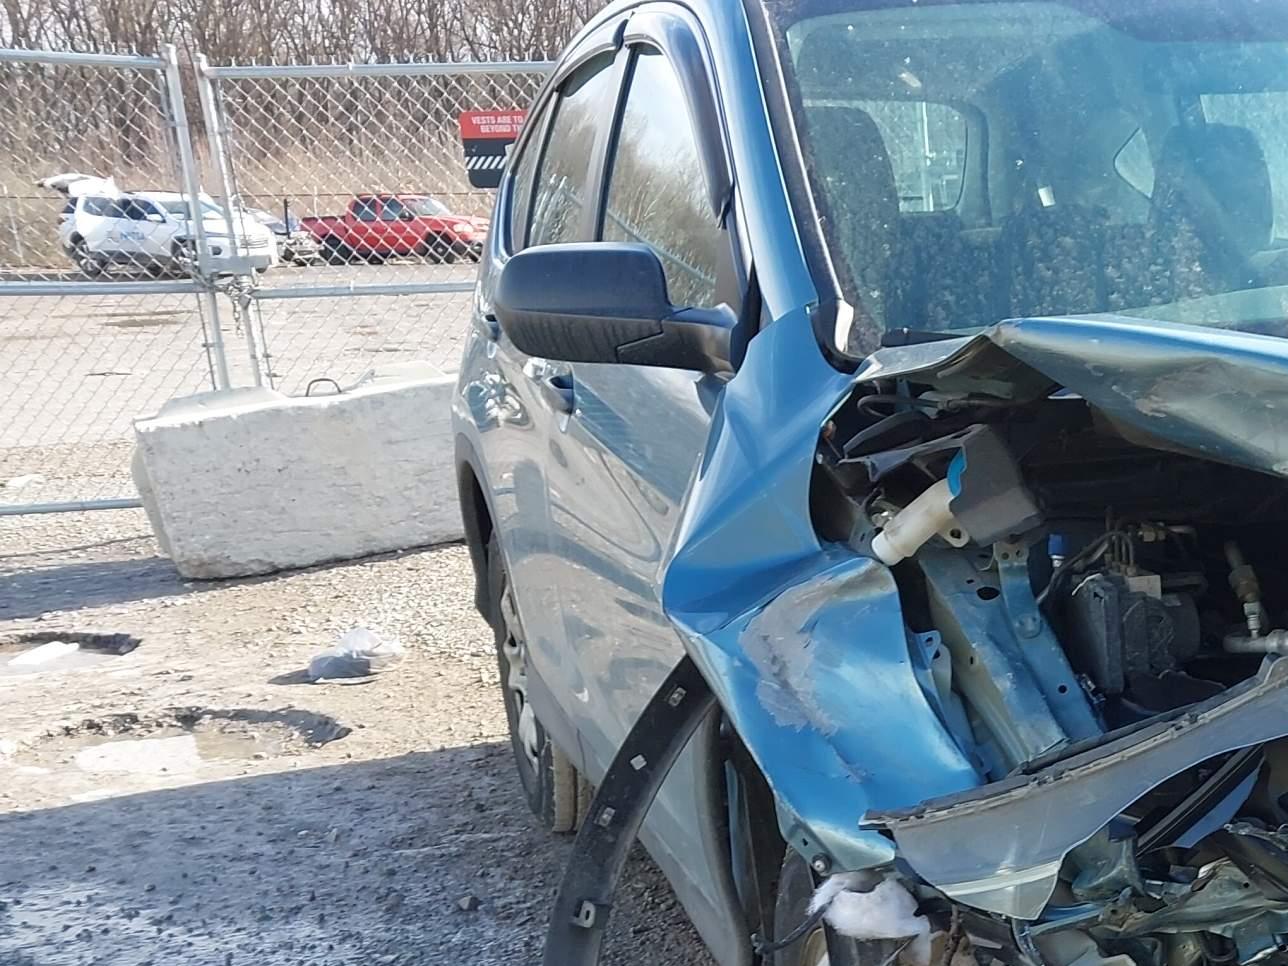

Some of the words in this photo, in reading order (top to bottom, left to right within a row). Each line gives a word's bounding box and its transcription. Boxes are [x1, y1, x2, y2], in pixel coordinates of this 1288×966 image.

[471, 115, 495, 125] VESTS
[496, 115, 512, 124] ARE
[512, 115, 524, 124] TO
[480, 124, 511, 133] BEYOND
